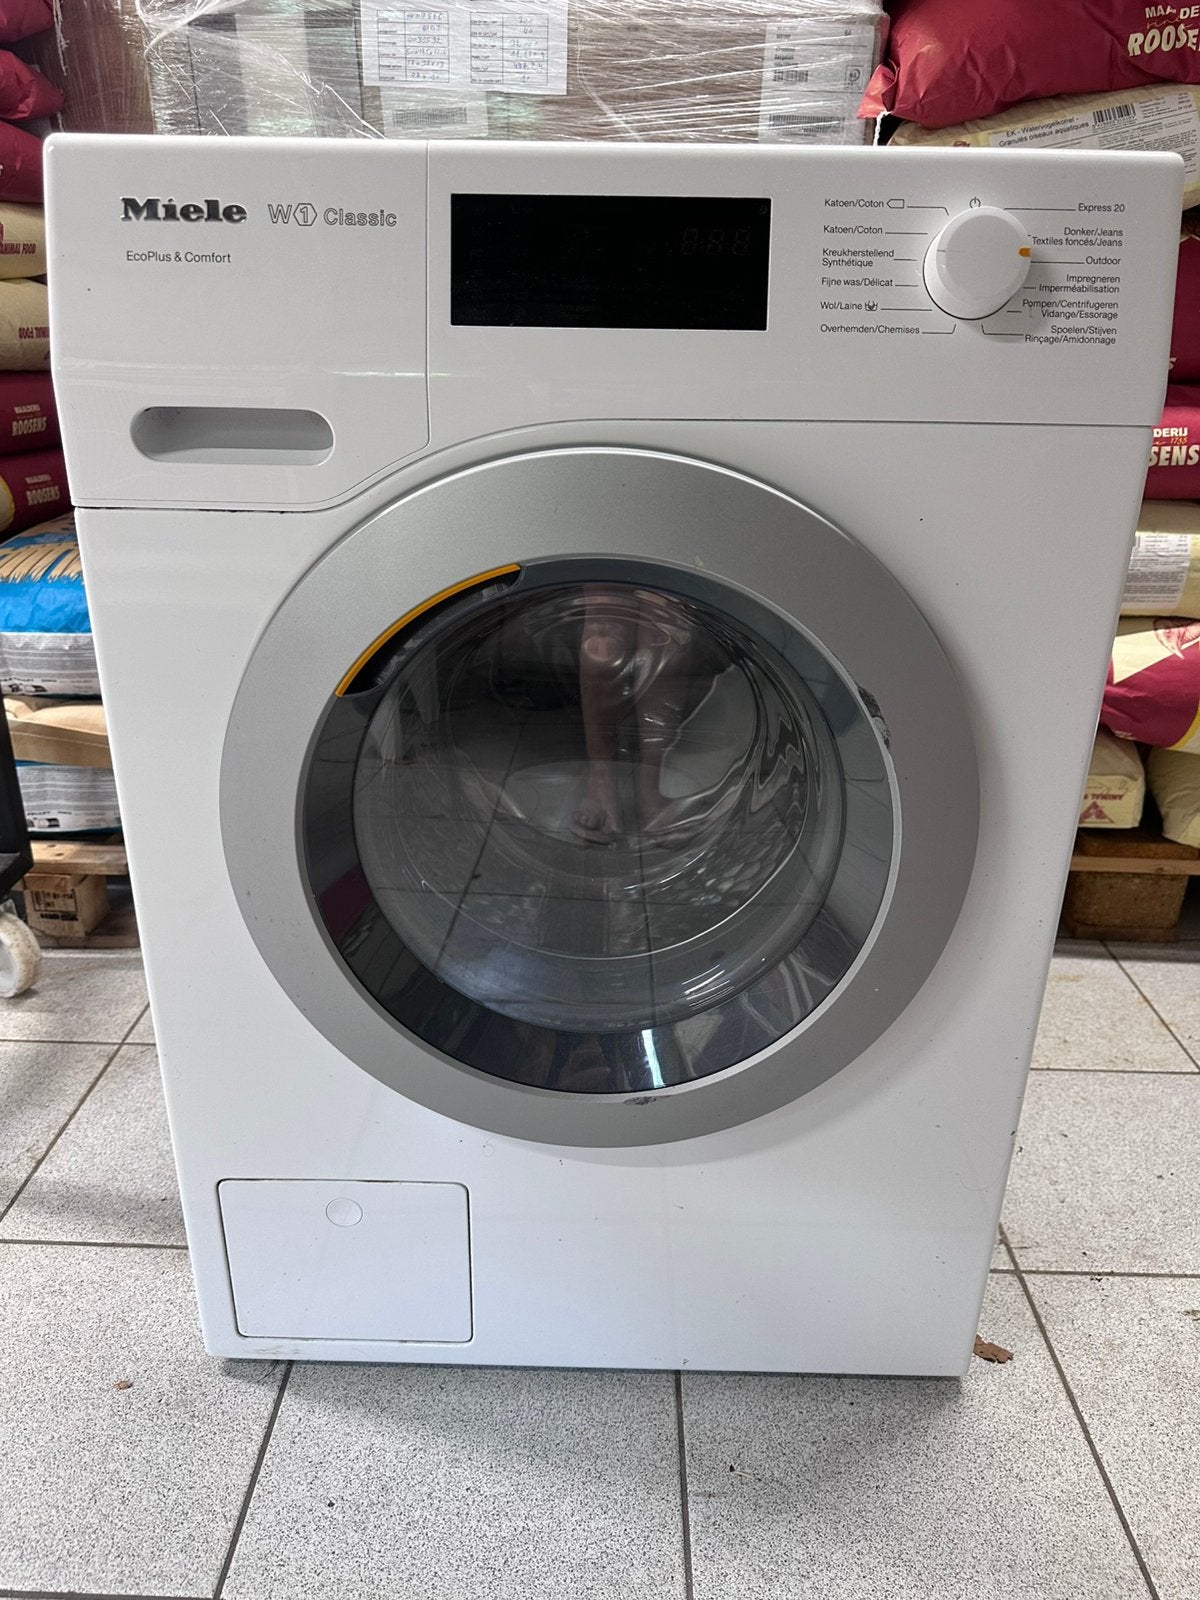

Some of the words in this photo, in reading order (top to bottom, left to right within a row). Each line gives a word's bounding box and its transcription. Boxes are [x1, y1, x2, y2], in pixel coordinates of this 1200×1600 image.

[1127, 23, 1200, 57] ROOSE
[824, 198, 885, 209] Katoen/Coton
[1078, 203, 1112, 213] Express
[1113, 204, 1126, 213] 20
[121, 197, 248, 224] Miele
[323, 207, 398, 227] Classic
[823, 225, 883, 235] Katoen/Coton
[1064, 227, 1124, 237] Donker/Jeans
[1032, 236, 1064, 246] Textiles
[1065, 236, 1123, 247] foncés/Jeans
[126, 250, 172, 263] EcoPlus
[174, 252, 183, 263] &
[185, 251, 232, 264] Comfort
[822, 248, 895, 258] Kreukherstellend
[822, 258, 873, 268] Synthétique
[1085, 256, 1122, 266] Outdoor
[821, 277, 842, 288] Fijne
[843, 277, 893, 287] was/Délicat
[1066, 274, 1120, 284] Impregneren
[1039, 283, 1120, 294] Imperméabilisation
[820, 301, 863, 311] Wol/Laine
[1022, 299, 1119, 310] Pompen/Centrifugeren
[1041, 310, 1118, 320] Vidange/Essorage
[820, 324, 920, 334] Overhemden/Chemises
[1051, 325, 1117, 335] Spoelen/Stijven
[1025, 334, 1116, 345] Rinçage/Amidonnage
[12, 417, 46, 436] ROOSENS
[1153, 427, 1188, 437] DERIJ
[1148, 444, 1200, 467] SENS
